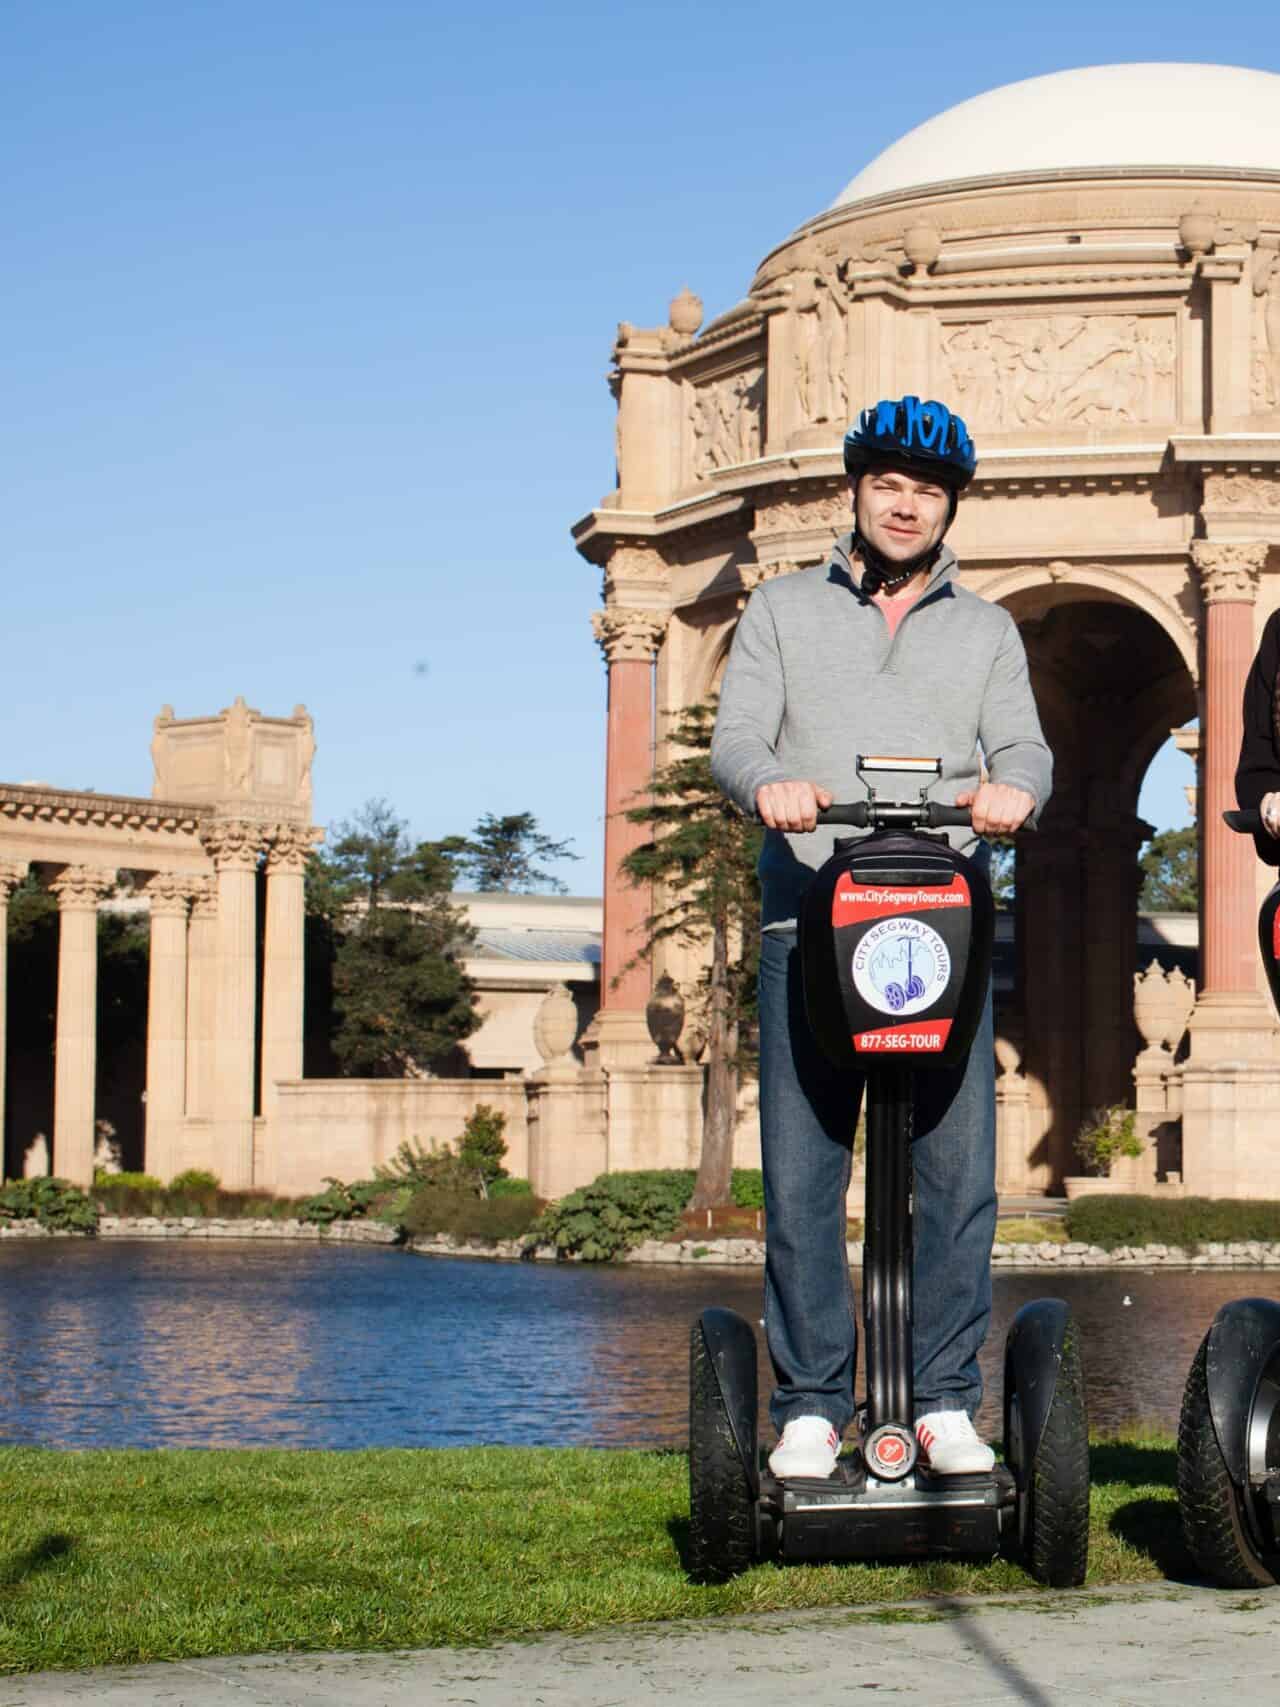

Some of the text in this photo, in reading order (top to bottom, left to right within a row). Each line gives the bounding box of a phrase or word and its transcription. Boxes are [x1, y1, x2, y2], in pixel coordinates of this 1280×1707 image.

[840, 890, 964, 904] www.CitySegwayTours.com
[855, 920, 946, 982] CITY SEGWAY TOURS
[861, 1034, 941, 1048] 877-SEG-TOUR
